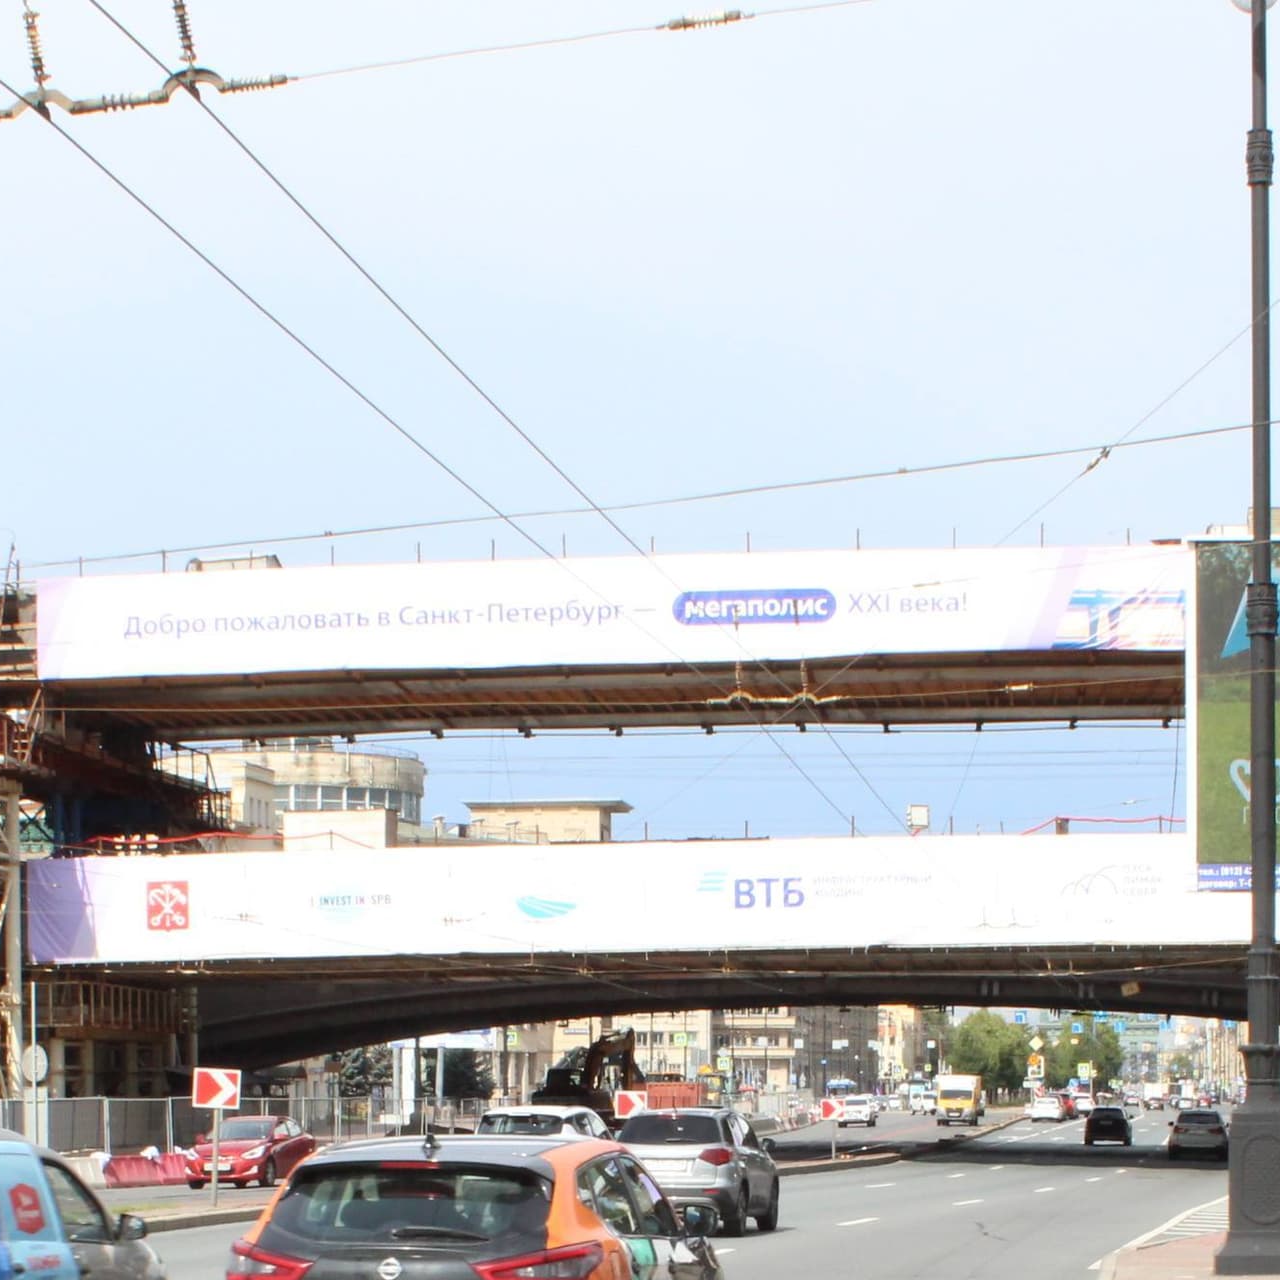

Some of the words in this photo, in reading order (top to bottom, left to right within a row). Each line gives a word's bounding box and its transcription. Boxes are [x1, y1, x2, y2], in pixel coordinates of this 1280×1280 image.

[124, 614, 206, 639] Добро
[214, 609, 369, 632] пожаловать
[378, 611, 391, 626] в
[399, 600, 623, 626] Санкт-Петербург
[684, 598, 827, 619] мегаполис
[847, 593, 890, 613] XXI
[900, 591, 968, 613] века!
[319, 895, 352, 906] INVEST
[370, 894, 392, 905] SPB
[734, 877, 805, 909] ВТБ
